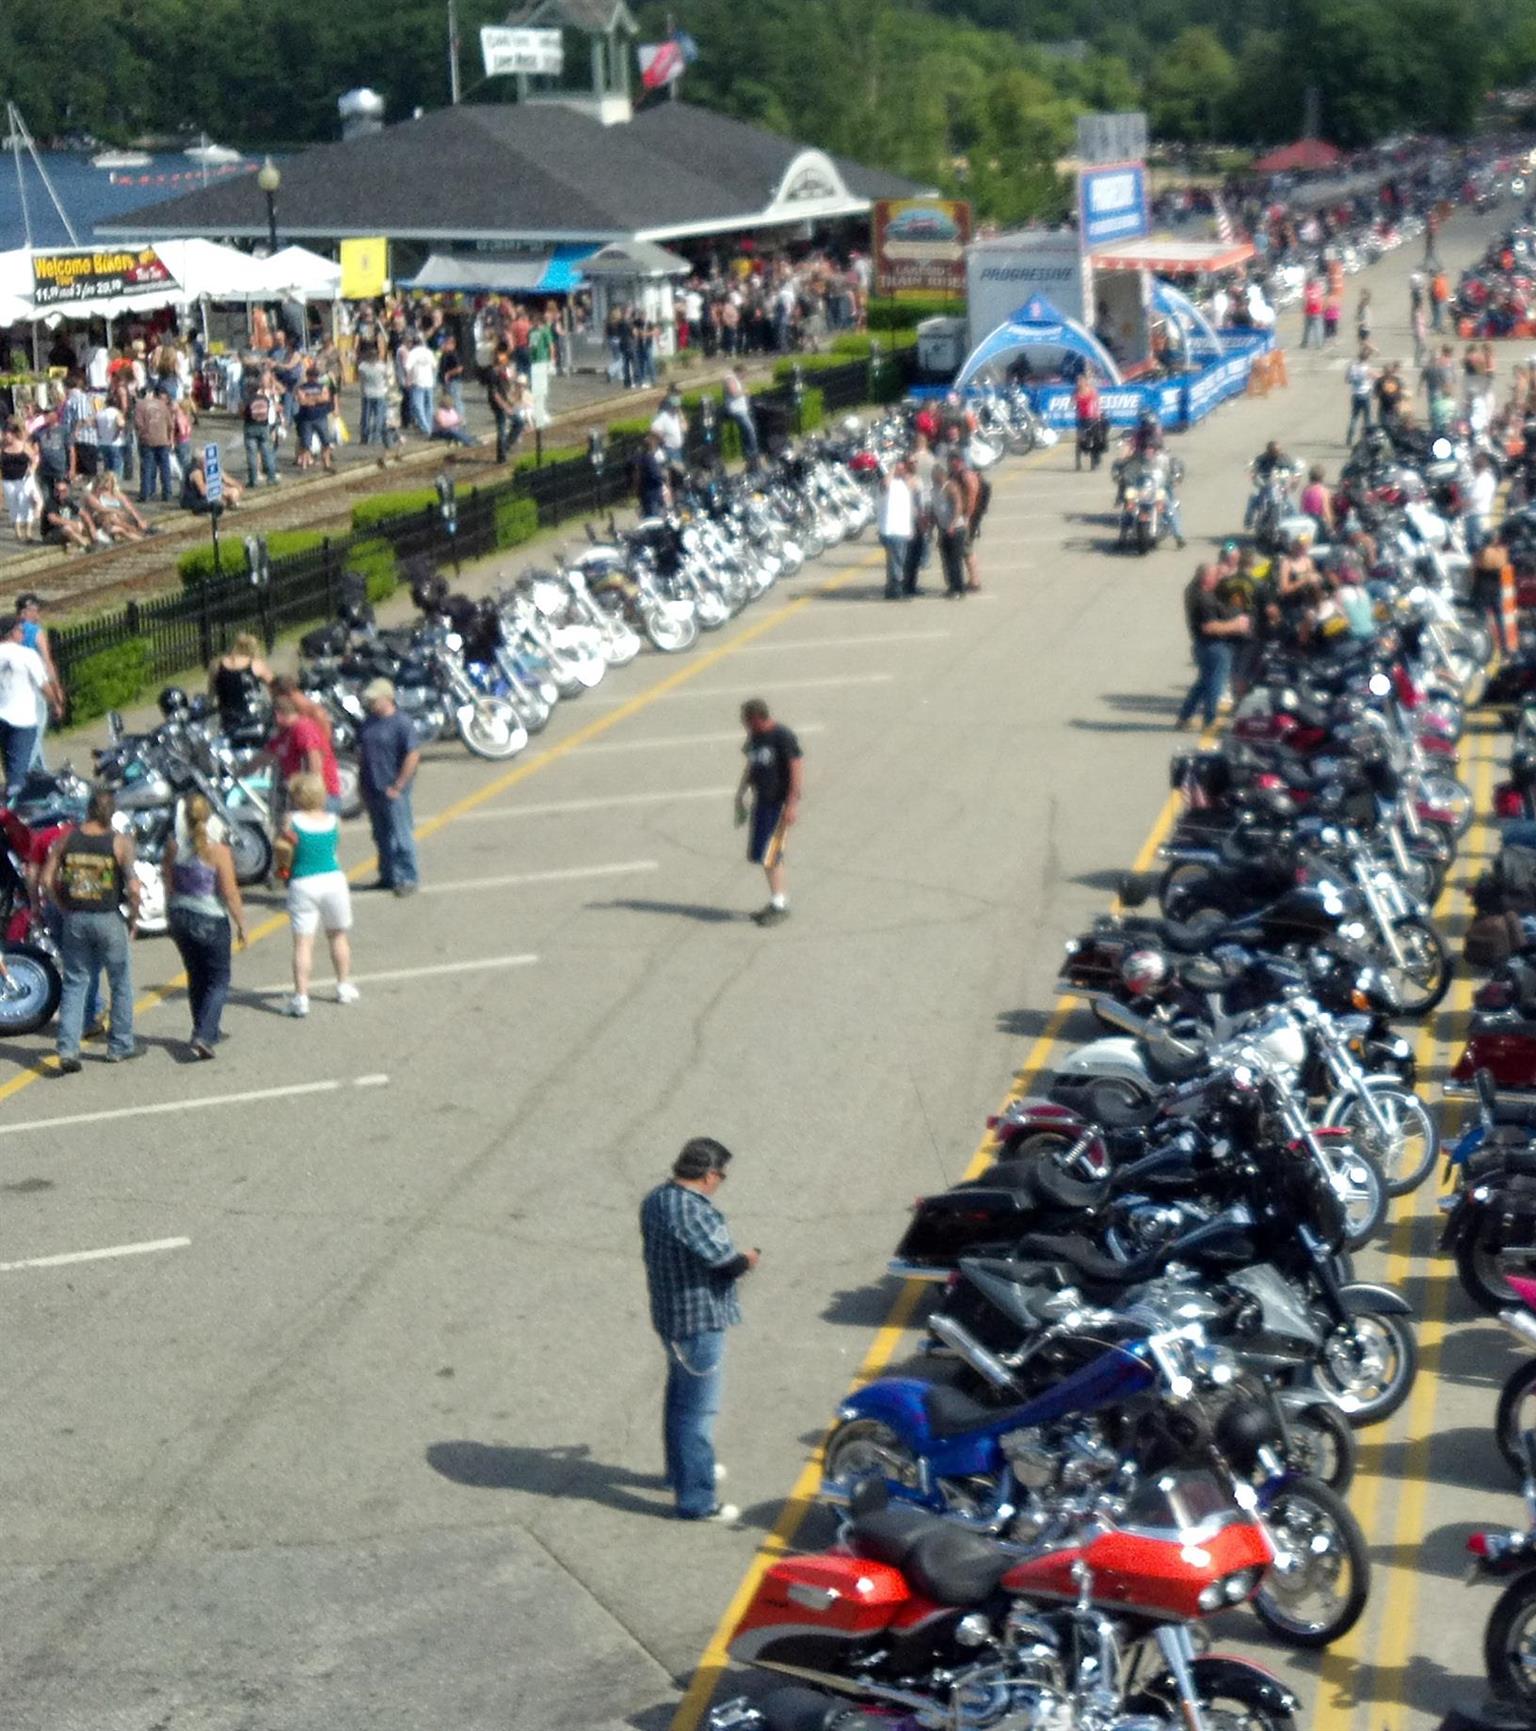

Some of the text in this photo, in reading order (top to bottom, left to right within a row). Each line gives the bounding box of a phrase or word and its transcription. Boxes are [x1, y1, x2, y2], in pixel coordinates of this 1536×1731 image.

[34, 257, 91, 278] Welcome
[93, 253, 134, 274] Bikers
[981, 268, 1073, 281] PROGRESSIVE
[1049, 394, 1142, 411] PRESSIVE
